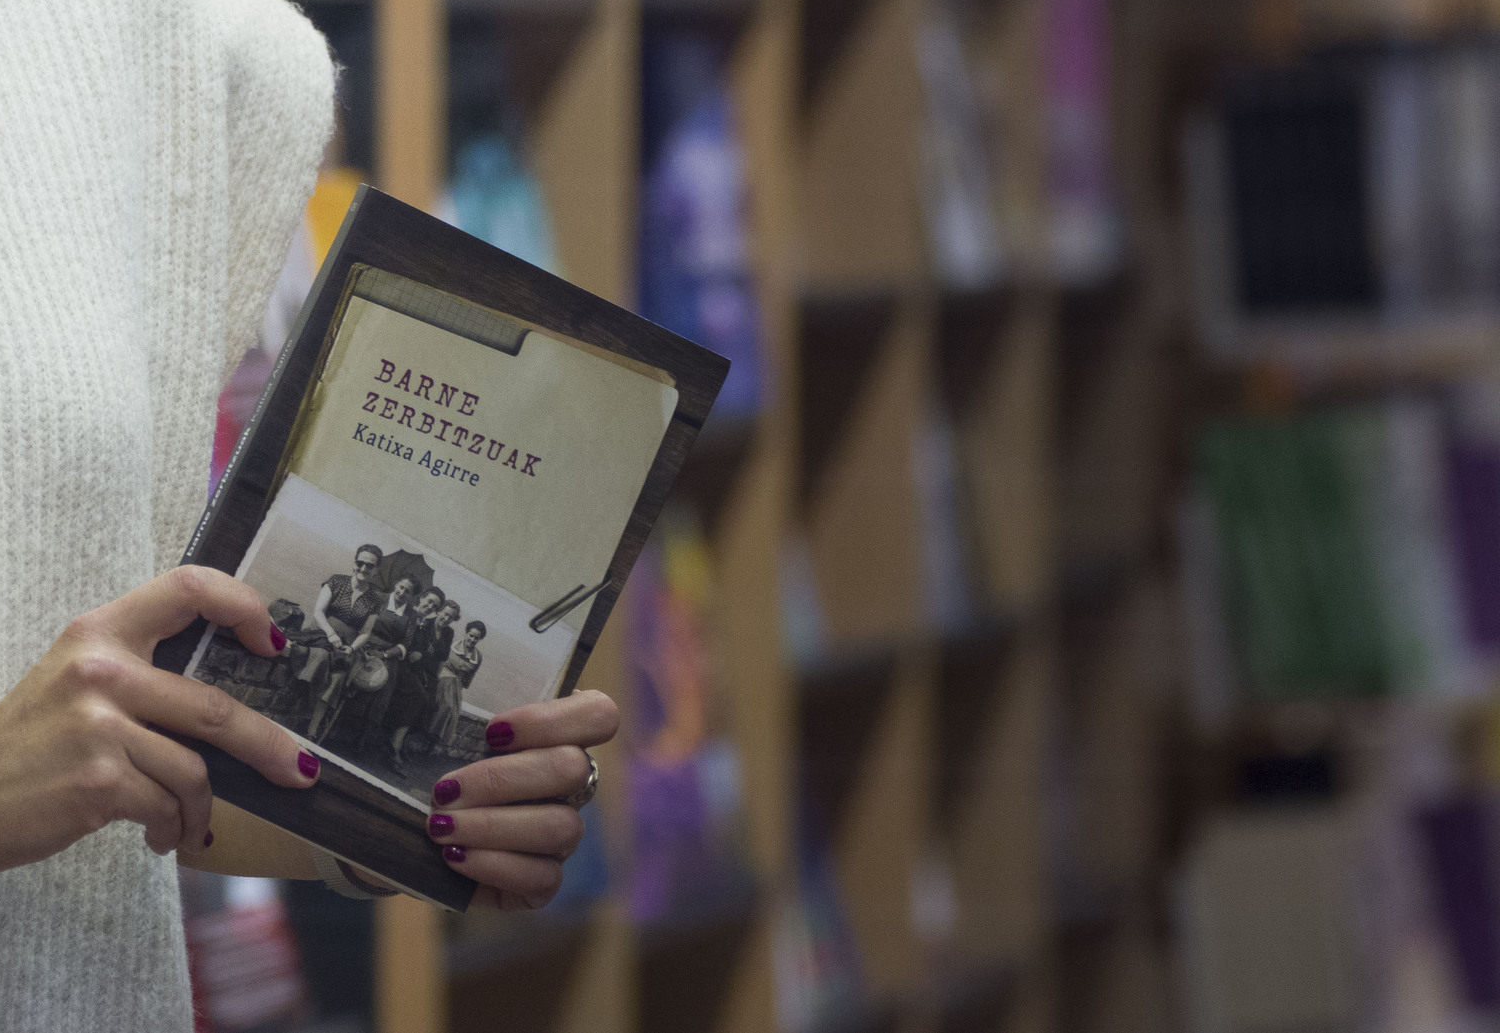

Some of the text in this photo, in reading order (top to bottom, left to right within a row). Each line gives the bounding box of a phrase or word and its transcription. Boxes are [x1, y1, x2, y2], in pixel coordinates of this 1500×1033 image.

[373, 358, 480, 417] BARNE
[187, 511, 211, 557] barne
[212, 427, 252, 508] zerbitzuak
[272, 339, 294, 379] Agirre
[352, 422, 481, 487] Katixa Agirre
[361, 391, 542, 477] ZERBITZUAK
